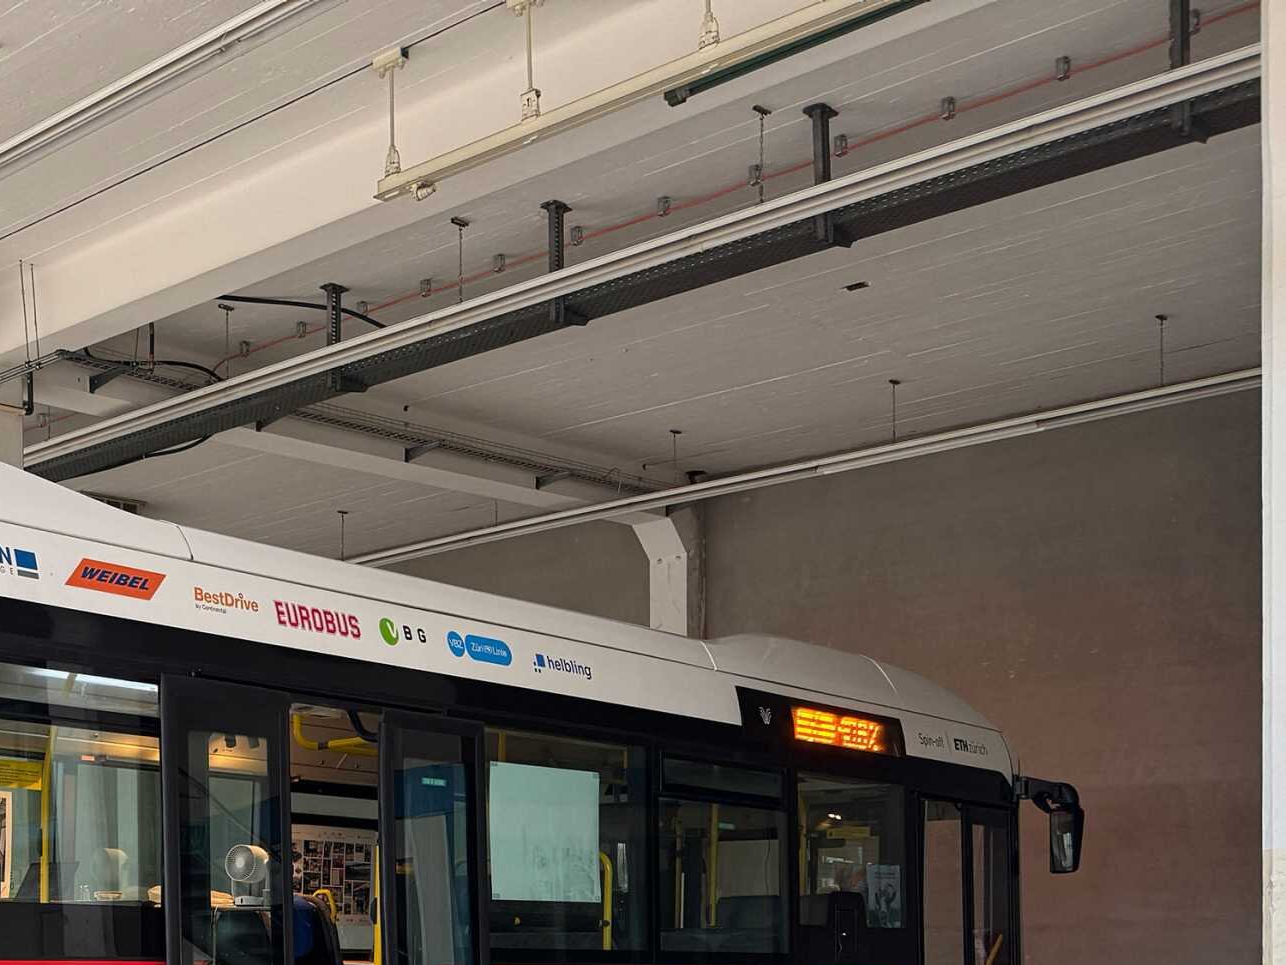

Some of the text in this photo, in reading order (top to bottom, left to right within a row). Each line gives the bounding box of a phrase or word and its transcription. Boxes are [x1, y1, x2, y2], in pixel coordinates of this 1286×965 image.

[81, 566, 150, 591] WEIBEL
[193, 586, 259, 612] BestDrive
[273, 600, 362, 640] EUROBUS
[546, 655, 592, 680] helbling
